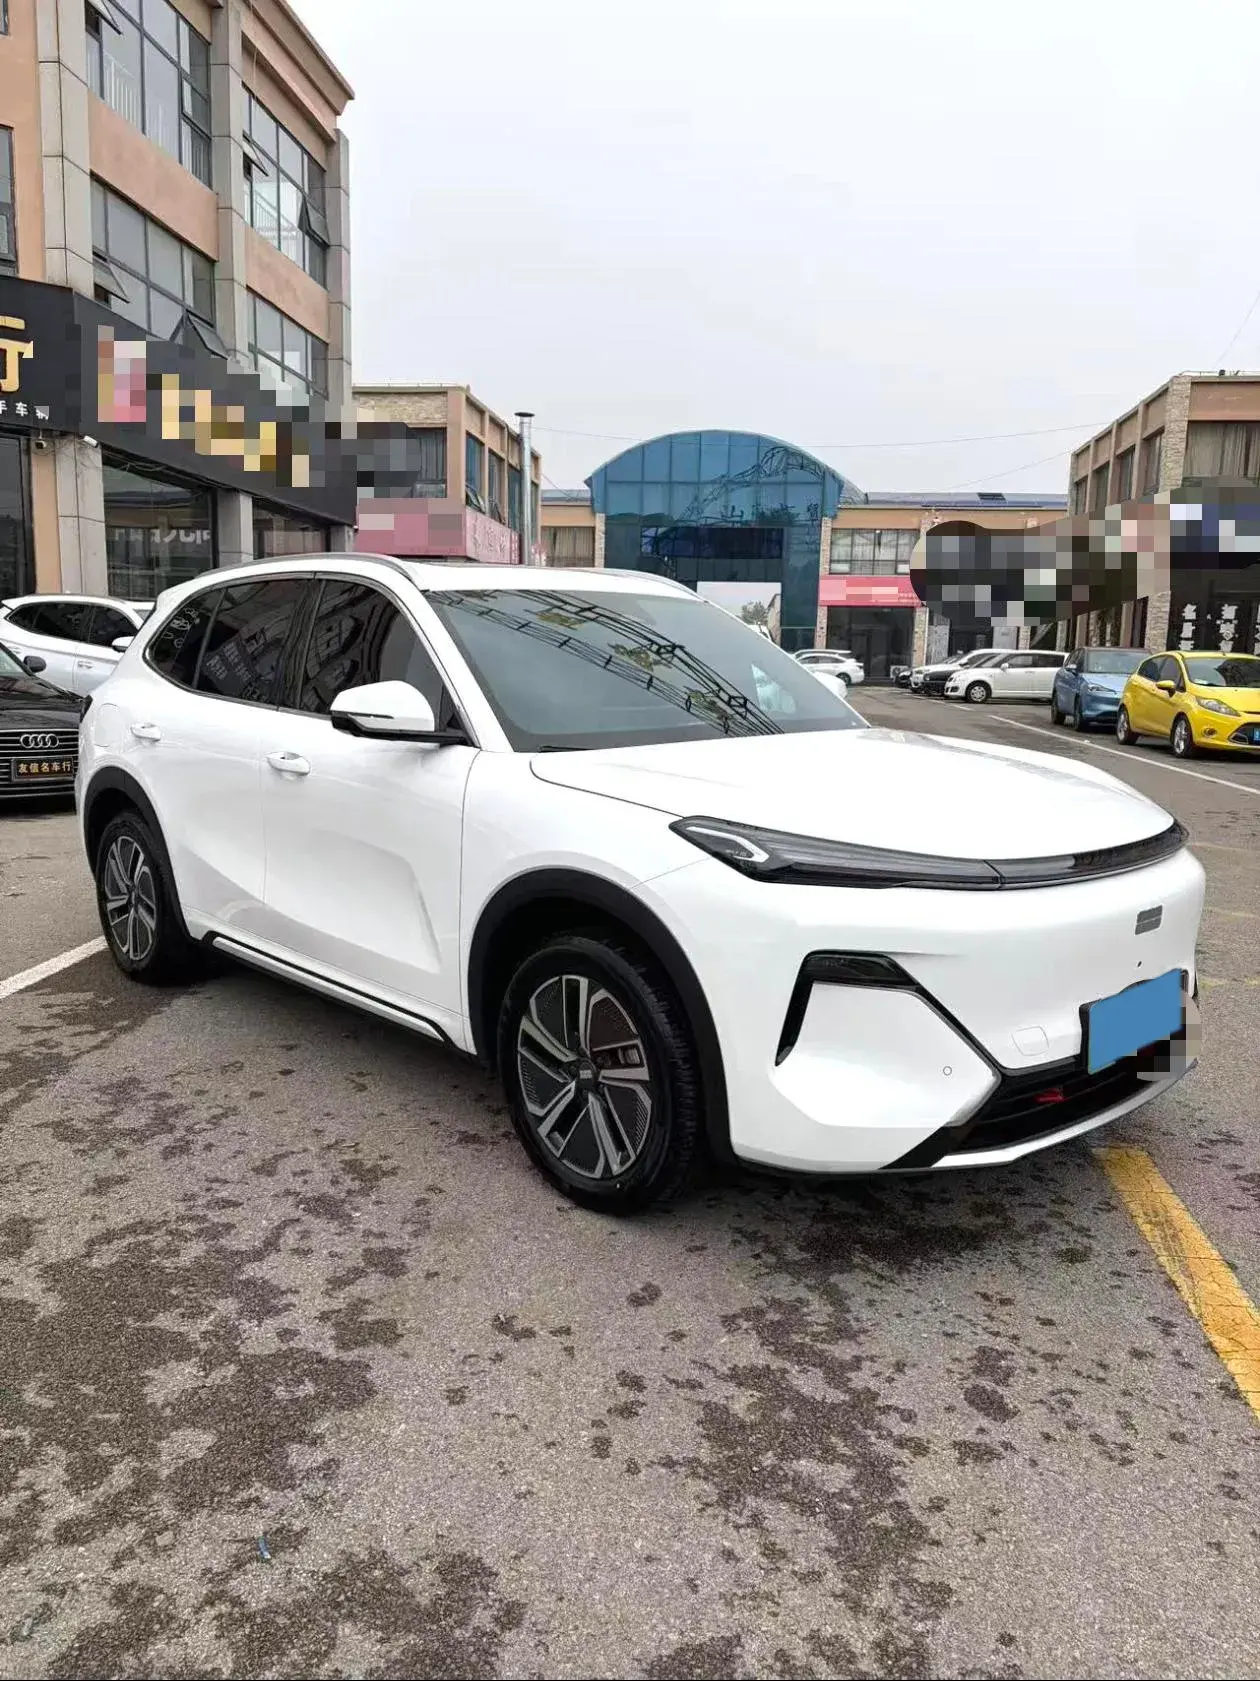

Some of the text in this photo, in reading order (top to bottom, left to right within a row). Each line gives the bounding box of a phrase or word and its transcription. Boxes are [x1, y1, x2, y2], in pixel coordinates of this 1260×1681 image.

[18, 761, 71, 773] 友信名车行
